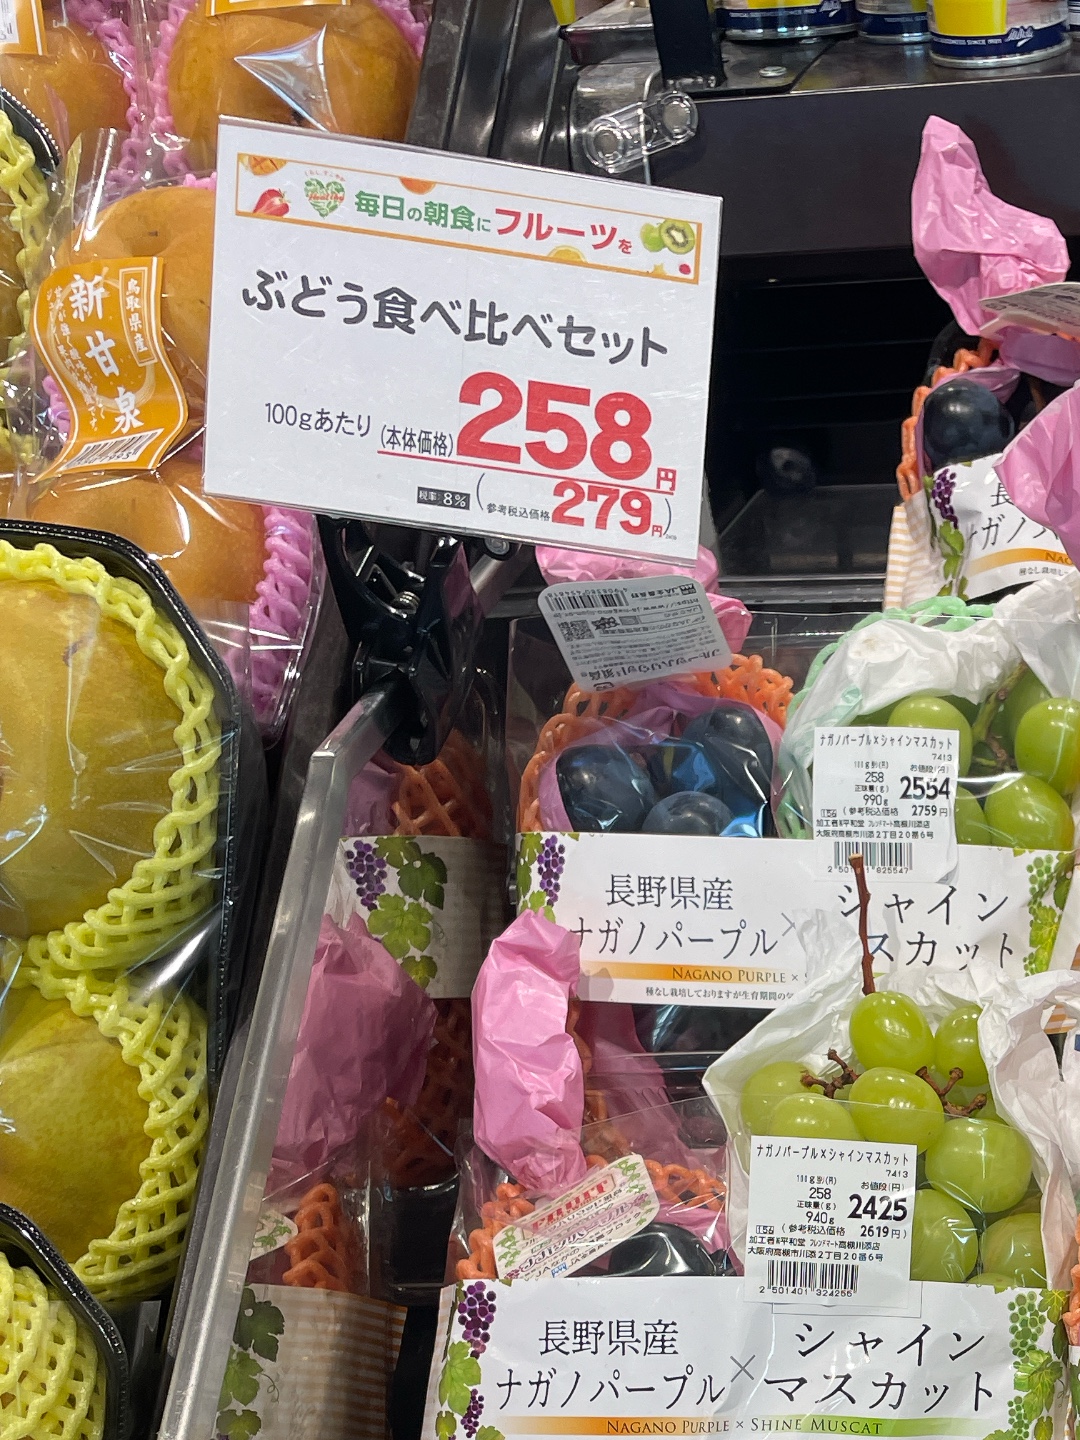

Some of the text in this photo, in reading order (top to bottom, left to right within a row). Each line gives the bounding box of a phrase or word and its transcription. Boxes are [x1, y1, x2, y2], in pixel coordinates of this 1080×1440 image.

[125, 278, 148, 353] 鳥取県産
[241, 269, 668, 369] ぶどう食べ比べセット
[69, 273, 144, 434] 新甘泉
[264, 402, 371, 439] 100gあたり
[456, 370, 654, 480] 258
[865, 772, 950, 800] 258 2554
[605, 873, 733, 910] 長野県産
[838, 884, 1008, 925] シャイン
[569, 916, 778, 959] ナガノパープル
[866, 931, 1013, 970] スカット
[672, 966, 786, 983] NAGANO PURPLE
[886, 1170, 908, 1178] 7413
[805, 1211, 835, 1225] 940g
[809, 1187, 908, 1222] 258 2425
[538, 1319, 679, 1356] 長野県産
[795, 1323, 985, 1367] シャイン
[496, 1364, 725, 1410] ナガノパープル
[764, 1372, 993, 1413] マスカット
[606, 1417, 883, 1435] NAGANO PURPLE SHINE MUSCAT
